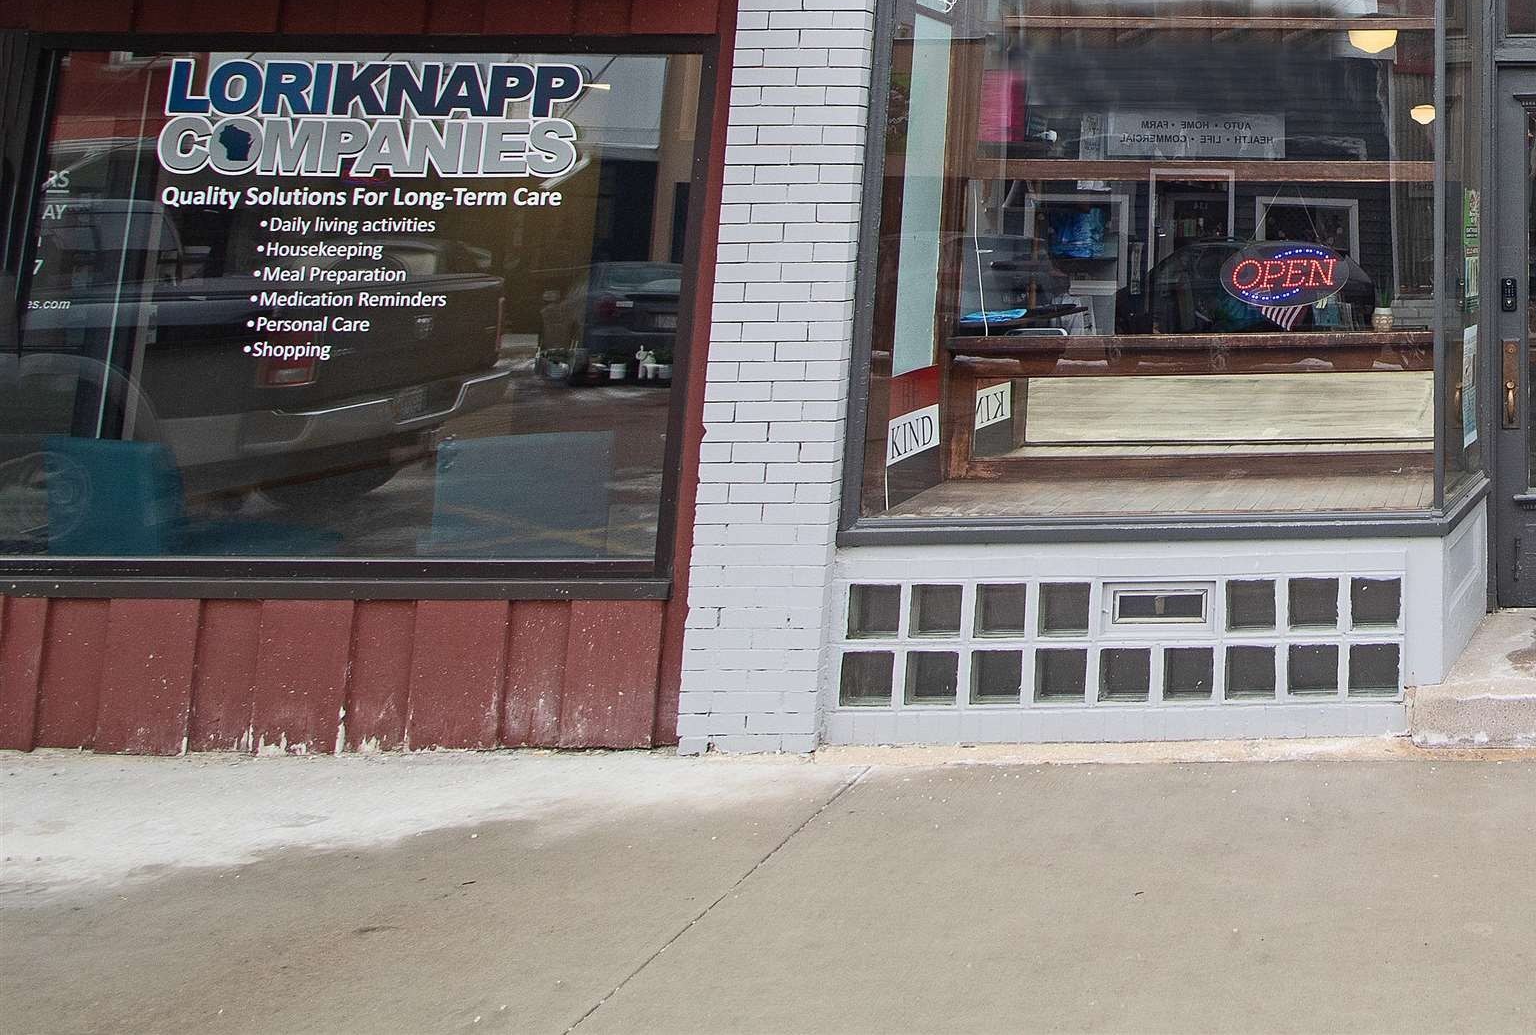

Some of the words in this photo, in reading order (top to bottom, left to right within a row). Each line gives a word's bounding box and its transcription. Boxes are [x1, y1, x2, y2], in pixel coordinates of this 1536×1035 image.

[157, 116, 579, 178] COMPANIES
[161, 185, 242, 211] Quality
[246, 186, 348, 207] Solutions
[354, 187, 390, 207] For
[394, 186, 508, 211] Long-Term
[513, 186, 563, 207] Care
[314, 216, 359, 235] living
[362, 217, 436, 232] activities
[309, 266, 407, 285] Preparation
[1232, 258, 1337, 289] OPEN
[358, 291, 447, 307] Reminders
[332, 316, 371, 332] Care
[890, 415, 933, 459] KIND
